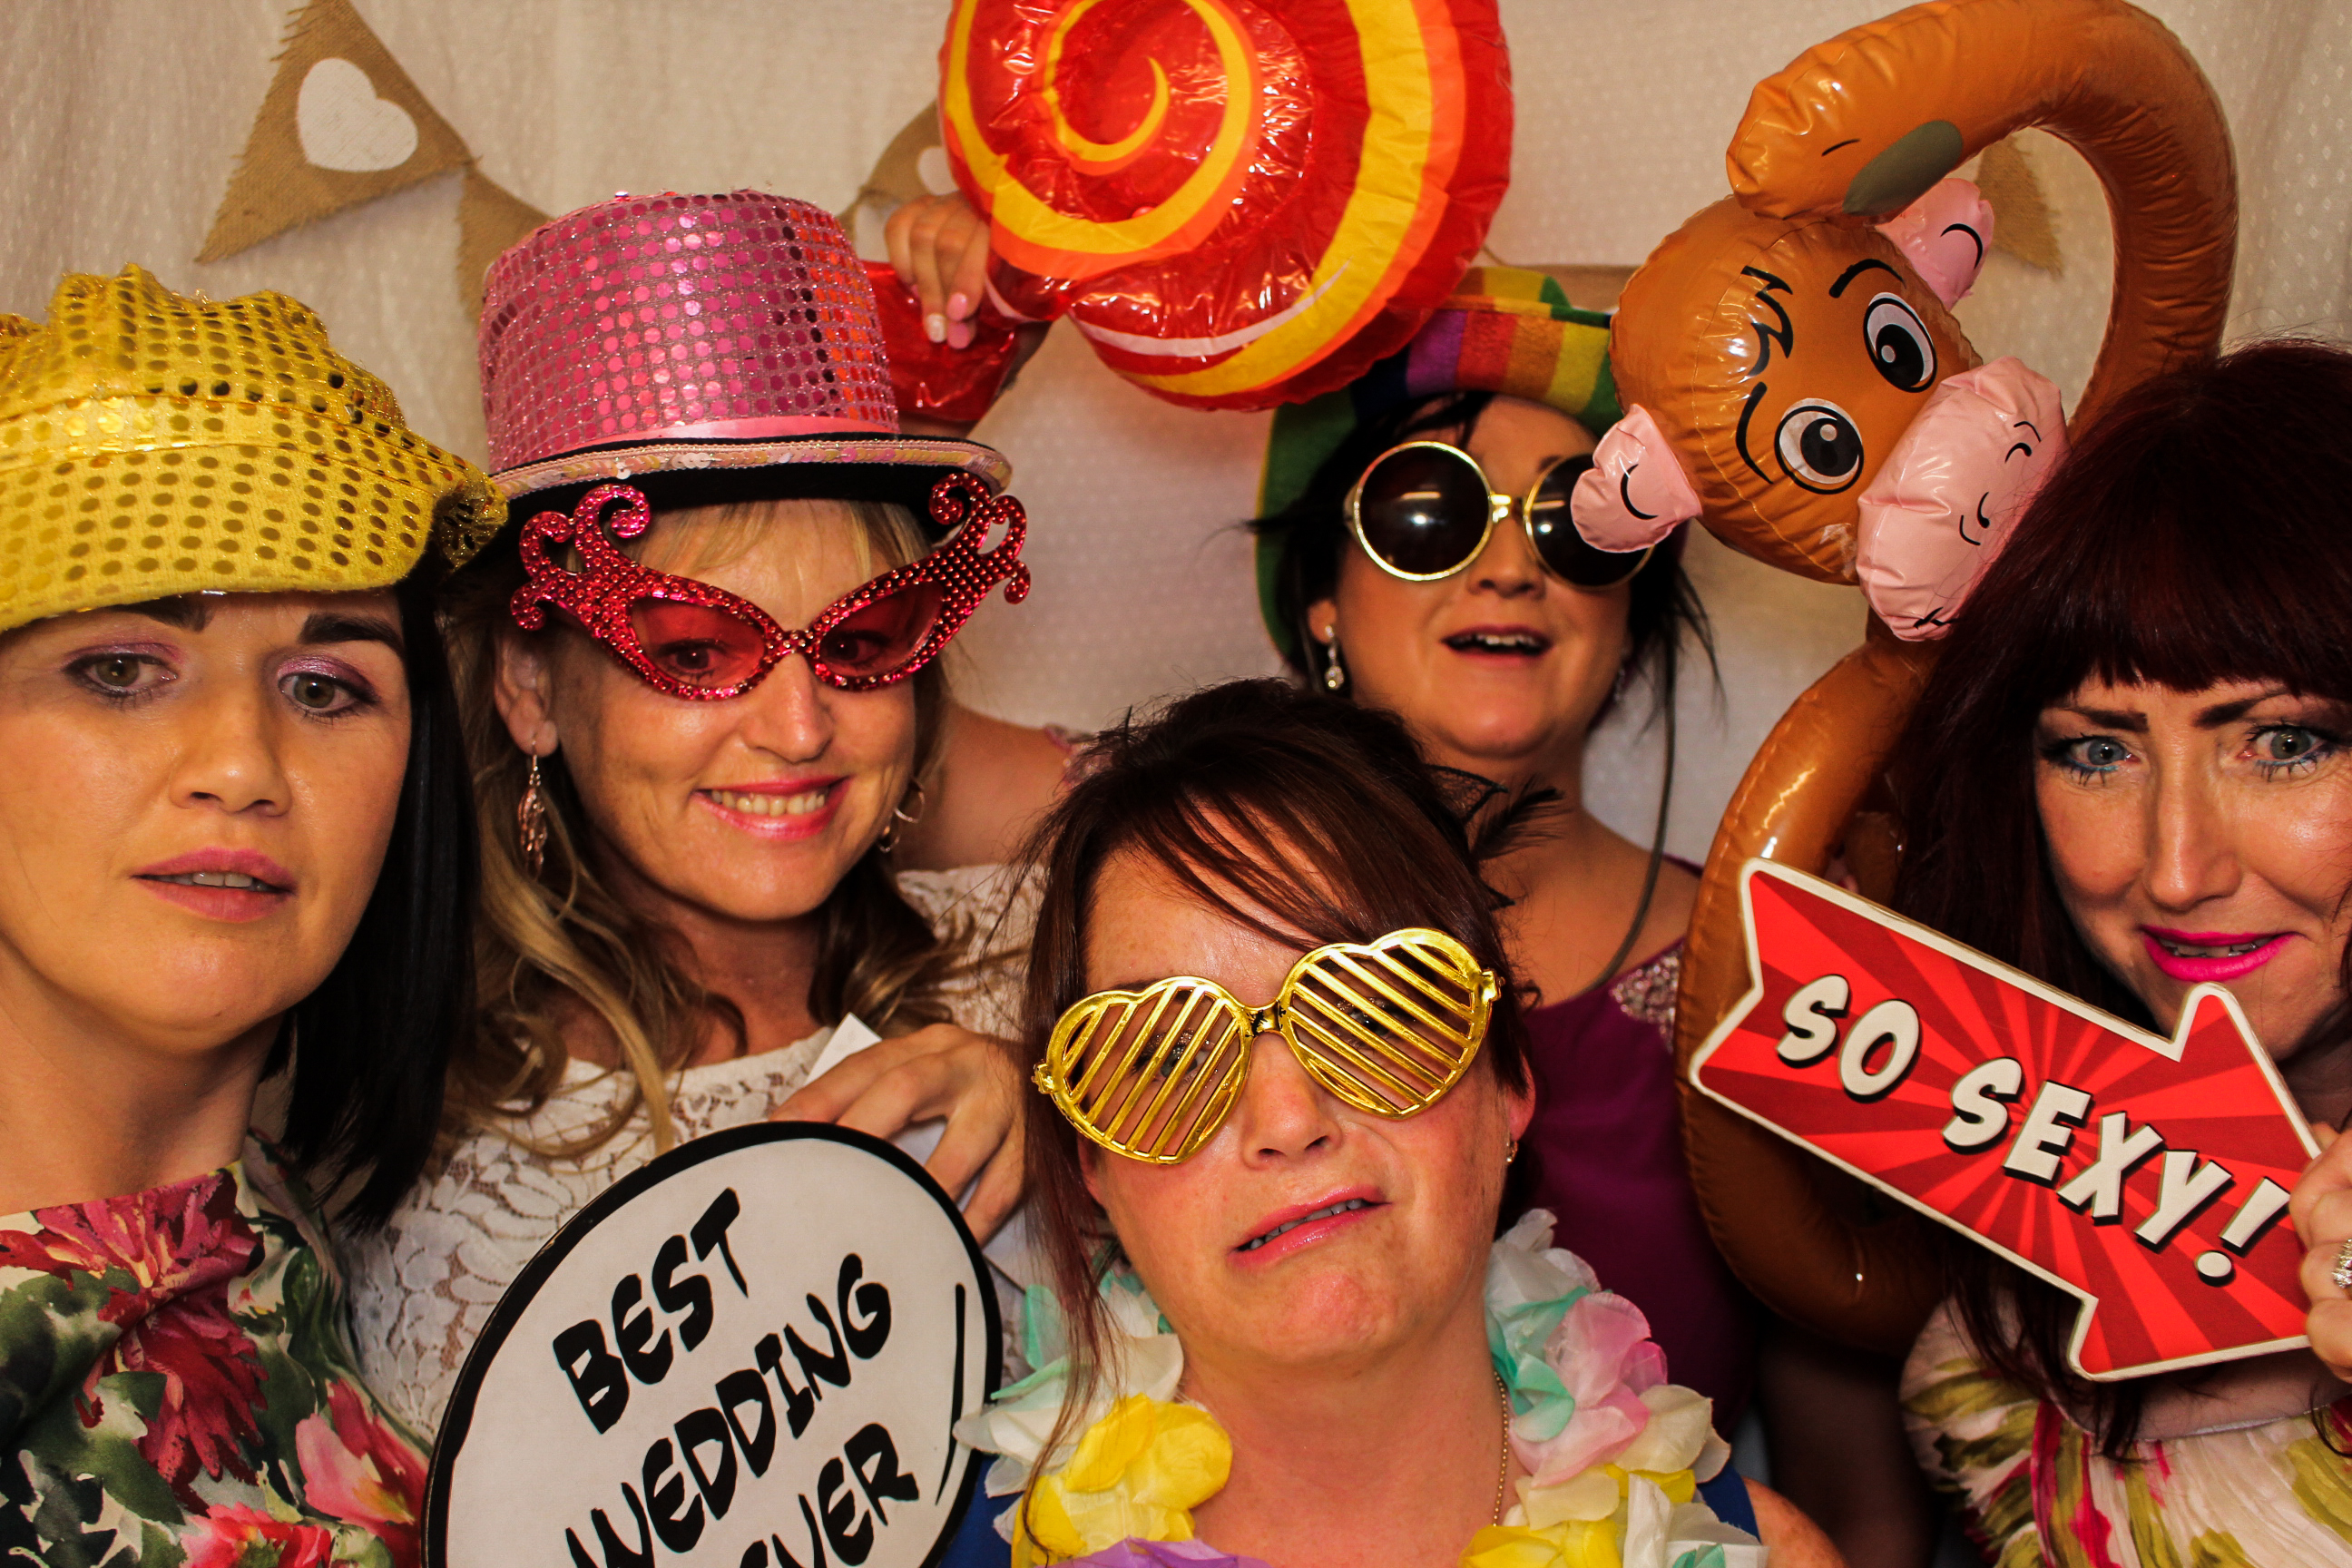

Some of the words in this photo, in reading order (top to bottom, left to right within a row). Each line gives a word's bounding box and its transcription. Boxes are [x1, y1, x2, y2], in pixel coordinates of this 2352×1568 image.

[1775, 974, 1921, 1102] SO
[1941, 1057, 2292, 1285] SEXY!
[552, 1187, 749, 1435] BEST
[564, 1252, 892, 1568] WEDDING
[740, 1422, 920, 1568] VER
